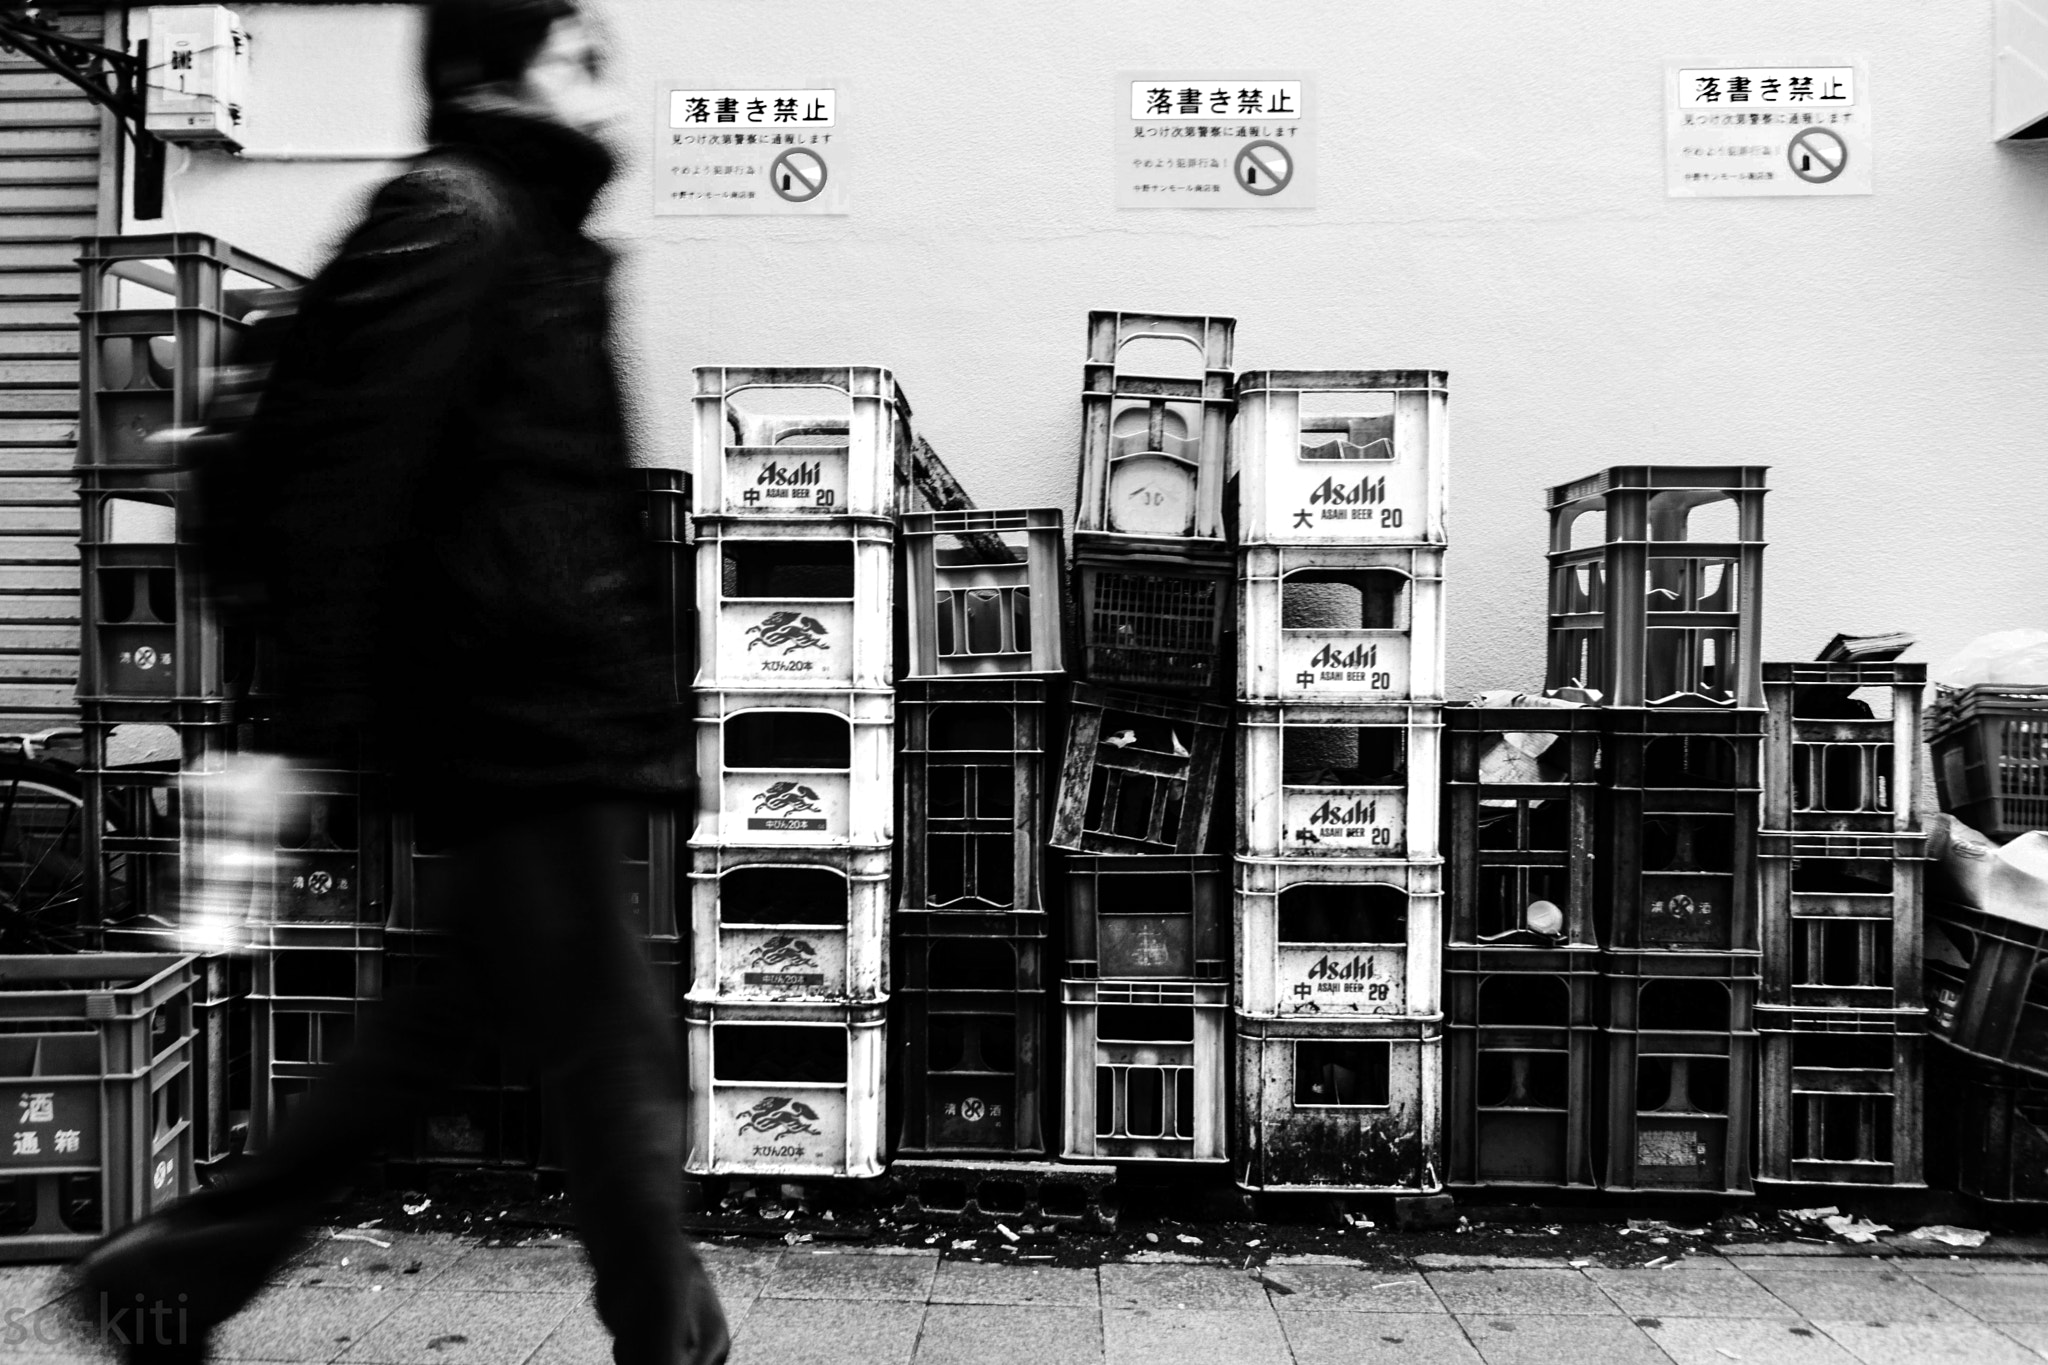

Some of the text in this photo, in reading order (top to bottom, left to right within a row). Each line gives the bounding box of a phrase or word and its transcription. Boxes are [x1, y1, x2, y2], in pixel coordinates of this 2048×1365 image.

[1146, 88, 1294, 115] 落書き禁止
[1695, 76, 1847, 102] 落書き禁止
[685, 97, 829, 123] 落書き禁止
[672, 134, 833, 145] 見つけ次第警察に通報します
[1133, 126, 1299, 138] 見つけ次第警察に通報します
[757, 461, 821, 486] Asahi
[743, 488, 834, 506] 中 ASAHI BEER 20
[1309, 475, 1385, 505] Asahi
[1293, 508, 1402, 529] 大 ASAHI BEER 20
[761, 661, 814, 671] 大びん20本
[1311, 643, 1377, 669] Asahi
[1296, 670, 1390, 689] 中 ASAHI BEER 20
[1309, 799, 1376, 825] Asahi
[1320, 827, 1343, 837] ASAHI
[1371, 828, 1390, 845] 20
[1308, 954, 1374, 980] Asahi
[1293, 982, 1312, 1000] 中
[1317, 982, 1341, 993] ASAHI
[18, 1092, 54, 1124] 酒
[13, 1129, 81, 1155] 通箱
[753, 1146, 805, 1157] 大びん20本
